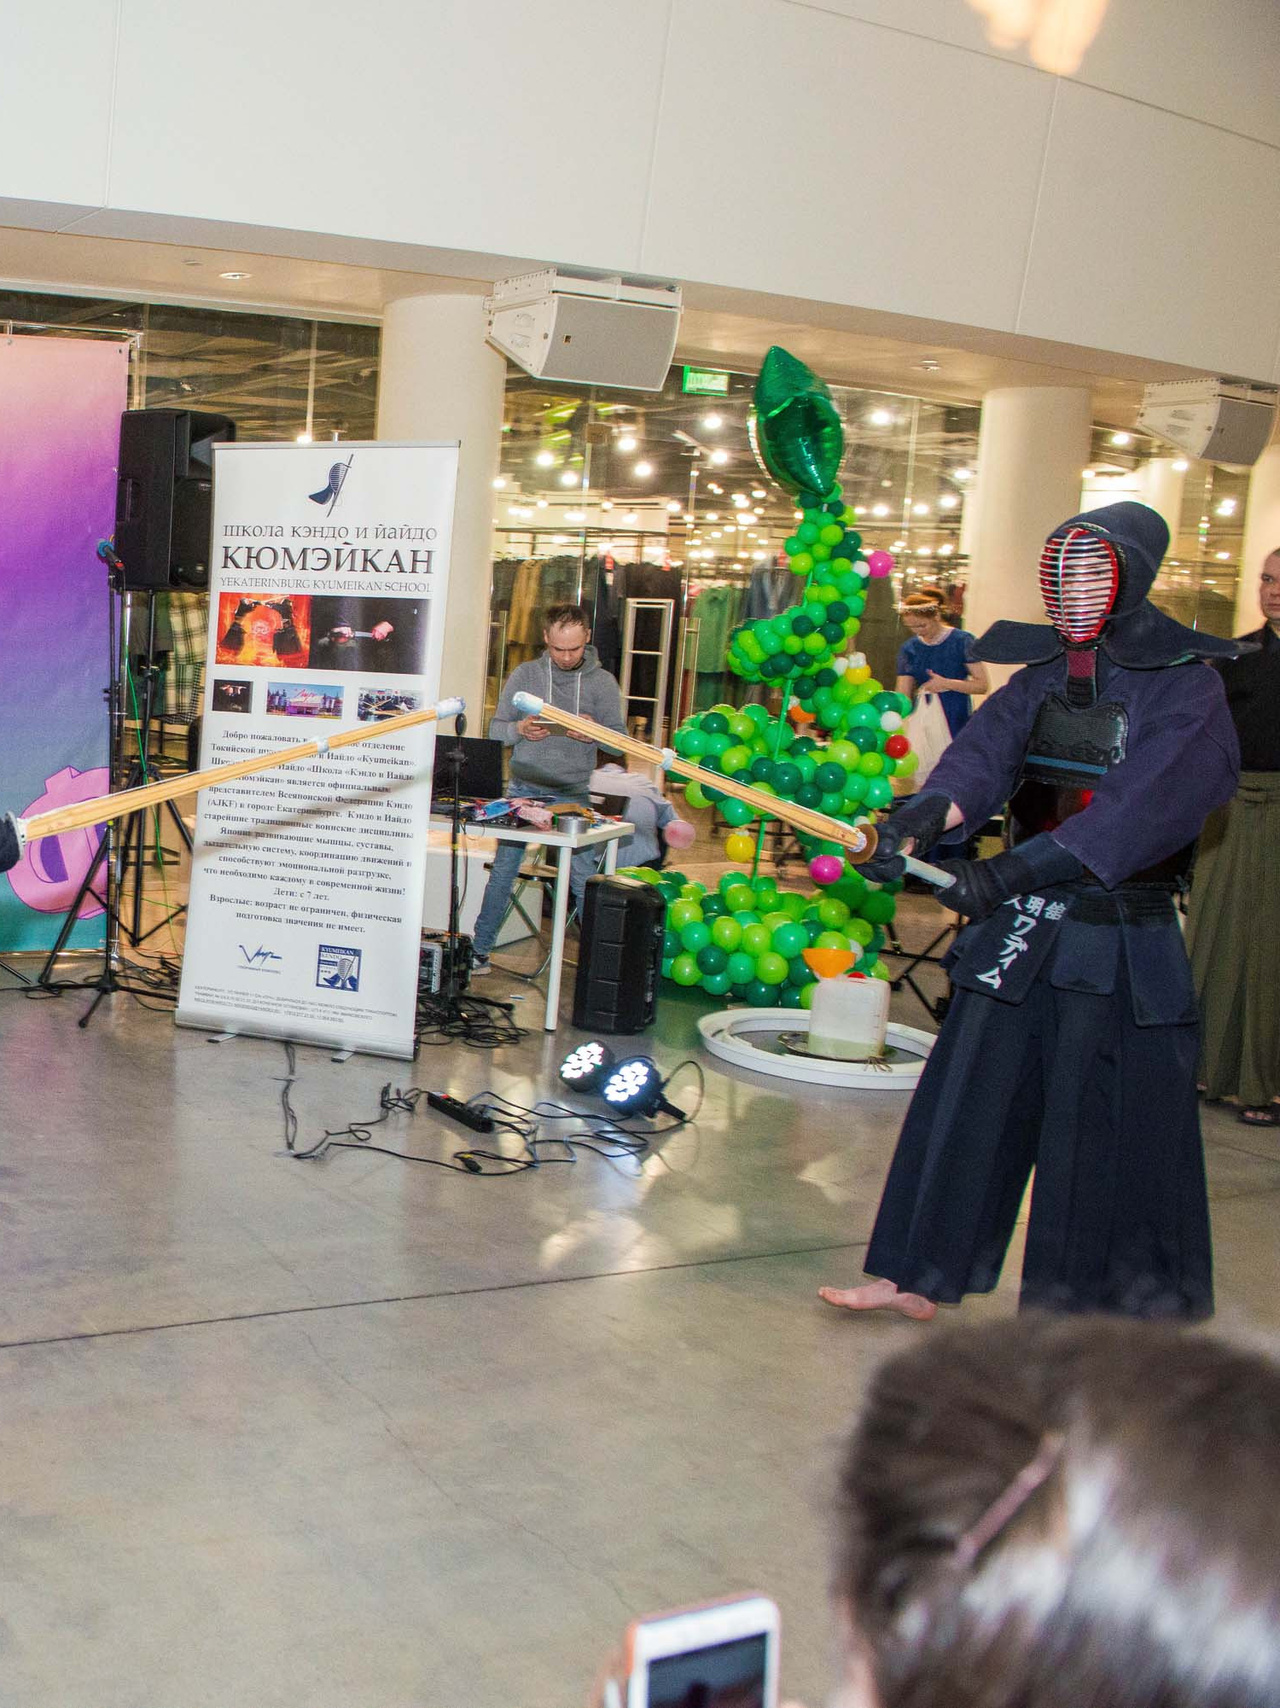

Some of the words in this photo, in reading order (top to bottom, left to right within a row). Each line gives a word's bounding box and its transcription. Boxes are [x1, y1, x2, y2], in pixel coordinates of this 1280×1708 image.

[222, 525, 284, 538] школа
[291, 526, 349, 541] кэндо
[355, 527, 368, 538] и
[221, 541, 435, 574] КЮМЭЙКАН
[220, 577, 310, 589] YEKATERINBURG
[312, 579, 382, 592] KYUMEIKAN
[384, 581, 432, 593] SCHOOL
[222, 729, 248, 742] Добро
[250, 733, 300, 743] пожаловать
[362, 741, 406, 752] отделение
[211, 743, 256, 754] Токийской
[327, 751, 354, 762] Иайдо
[307, 764, 342, 775] «Школа
[345, 767, 377, 778] «Кэндо
[386, 770, 416, 781] Иайдо
[286, 778, 326, 789] является
[327, 781, 391, 794] официальным
[208, 786, 276, 798] представителем
[278, 789, 333, 803] Всеяпонской
[335, 795, 384, 807] Федерации
[386, 799, 413, 810] Кэндо
[247, 802, 275, 813] городе
[276, 803, 343, 819] Екатеринбурге.
[347, 810, 374, 821] Кэндо
[384, 813, 412, 825] Иайдо
[204, 812, 249, 824] старейшие
[251, 816, 313, 830] традиционные
[315, 823, 357, 834] воинские
[358, 827, 414, 839] дисциплины
[255, 831, 314, 844] развивающие
[316, 837, 354, 848] мышцы,
[356, 841, 394, 852] суставы,
[203, 840, 260, 852] дыхательную
[262, 845, 297, 858] систему,
[299, 850, 359, 862] координацию
[360, 855, 404, 867] движений
[218, 855, 275, 868] способствуют
[278, 862, 345, 875] эмоциональной
[347, 869, 392, 881] разгрузке,
[203, 867, 218, 875] что
[219, 869, 268, 880] необходимо
[269, 875, 307, 887] каждому
[316, 878, 373, 892] современной
[374, 886, 406, 896] жизни!
[273, 886, 298, 898] Дети:
[313, 893, 330, 901] лет.
[209, 893, 253, 906] Взрослые:
[254, 899, 286, 911] возраст
[300, 905, 349, 918] ограничен,
[350, 910, 402, 924] физическая
[235, 911, 282, 923] подготовка
[285, 917, 324, 928] значения
[326, 922, 337, 930] не
[338, 924, 366, 933] имеет.
